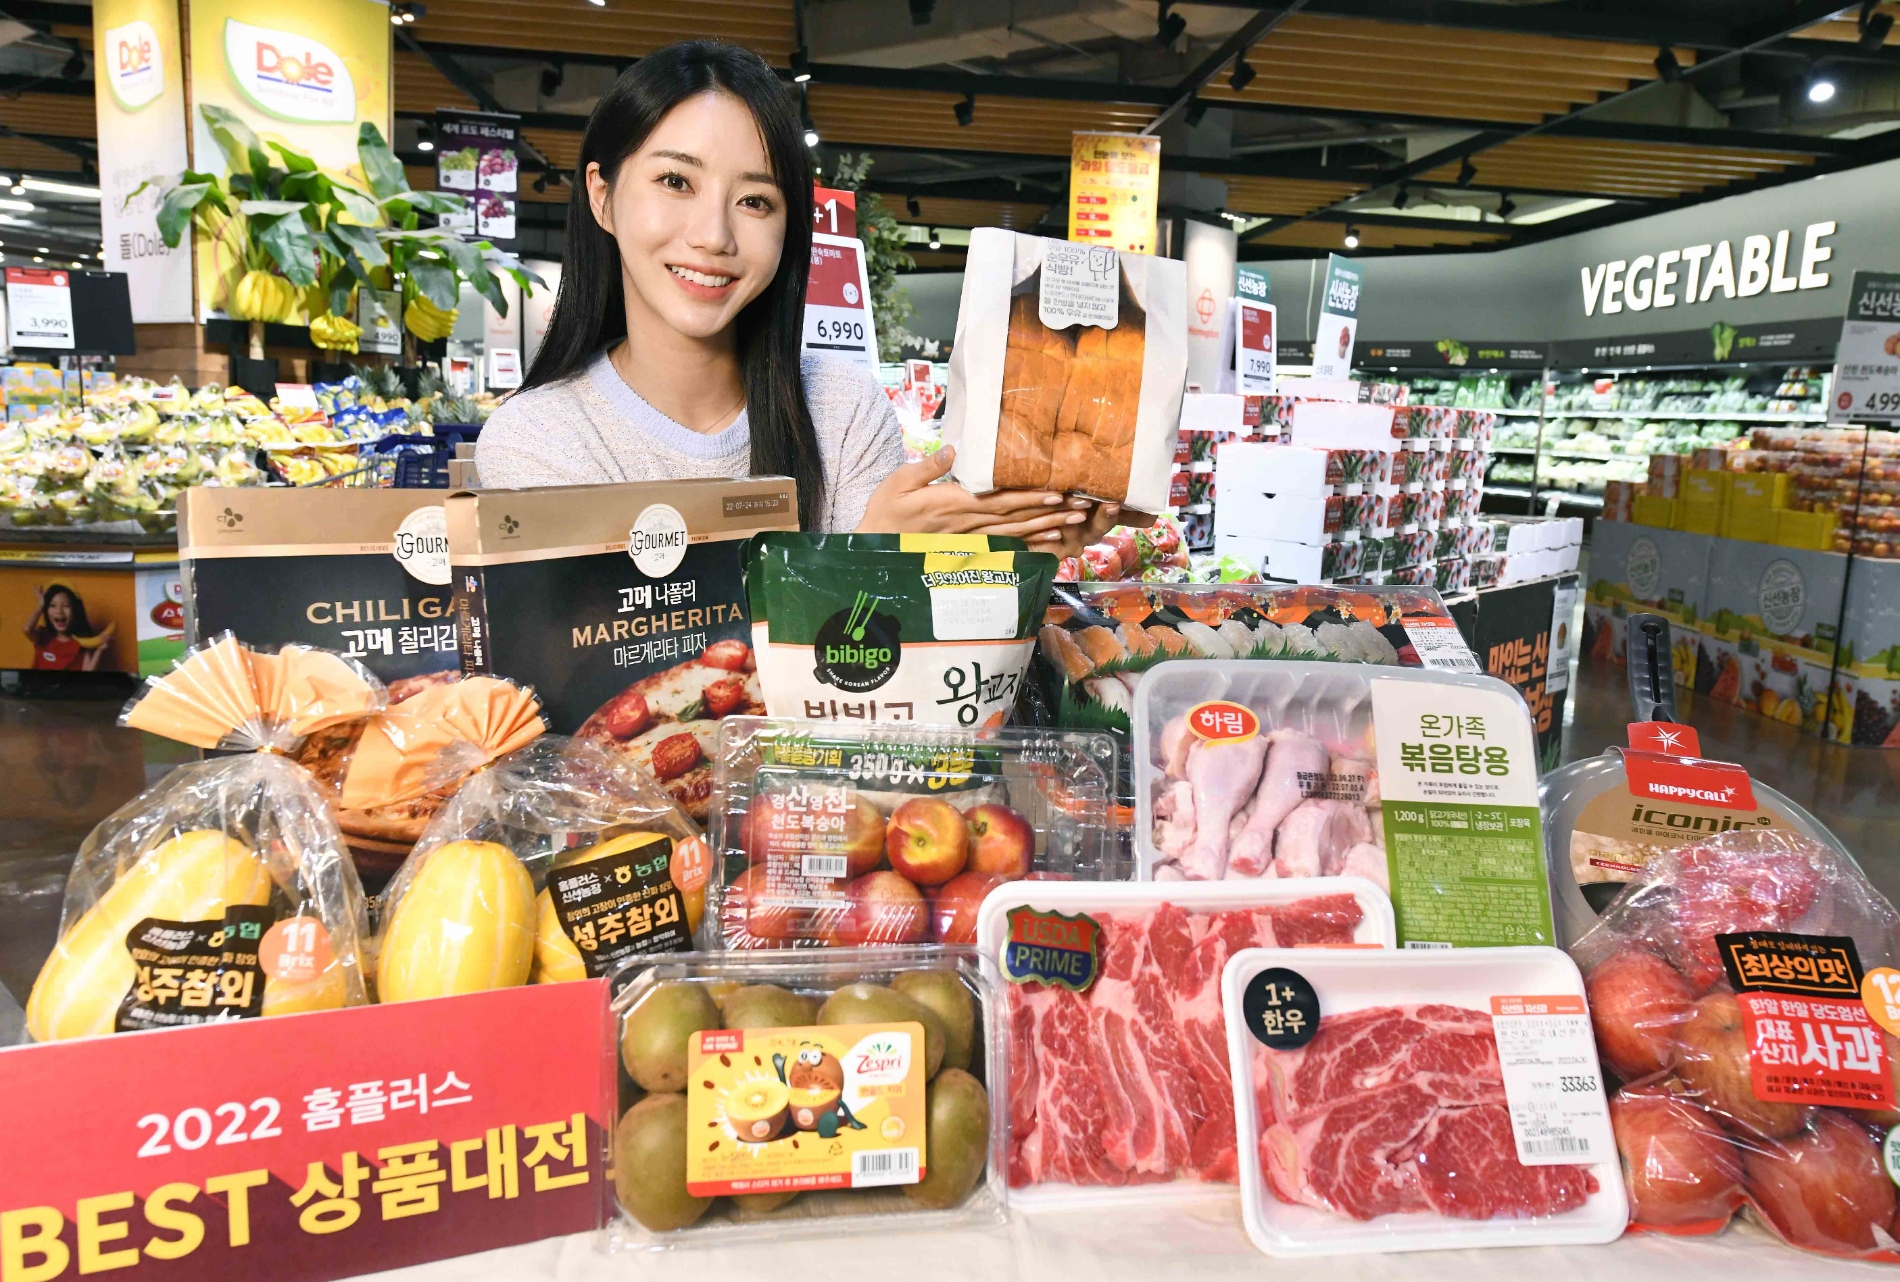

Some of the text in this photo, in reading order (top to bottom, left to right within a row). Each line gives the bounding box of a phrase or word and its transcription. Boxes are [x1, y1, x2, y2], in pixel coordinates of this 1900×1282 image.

[118, 37, 152, 73] Dole
[256, 41, 334, 85] Dole
[1581, 221, 1836, 316] VEGETABLE
[31, 317, 69, 330] 3,990
[1043, 306, 1065, 316] 100%
[817, 319, 865, 342] 6,990
[1250, 358, 1271, 374] 7,990
[935, 569, 982, 587] 맛있어진
[982, 571, 1022, 587] 왕교자!
[617, 580, 697, 614] 고메 나폴리
[305, 598, 411, 625] CHILI
[571, 602, 745, 650] MARGHERITA
[341, 626, 395, 659] 고메
[613, 631, 708, 669] 마르게리타 피자
[826, 644, 893, 670] bibigo
[825, 665, 892, 689] SHARE KOREAN FLAVOR
[1199, 710, 1244, 735] 하림
[1420, 713, 1486, 741] 온가족
[1400, 742, 1510, 777] 볶음탕용
[1648, 782, 1730, 805] HAPPYCALL
[770, 814, 848, 832] 천도복숭아
[678, 839, 702, 868] 11
[558, 872, 600, 892] 홈플러스
[682, 864, 704, 882] Brix
[561, 882, 602, 904] 신선농장
[591, 900, 616, 915] 고장이
[572, 894, 680, 951] 성주참외
[1022, 918, 1081, 949] USDA
[281, 922, 317, 953] 11
[278, 953, 316, 968] Brix
[1014, 945, 1085, 976] PRIME
[1265, 982, 1297, 1006] 1+
[1262, 1008, 1308, 1036] 한우
[1748, 997, 1780, 1016] 한알
[1780, 1000, 1810, 1019] 한알
[1810, 1003, 1870, 1023] 당도엄선
[1755, 1018, 1797, 1043] 대표
[1759, 1041, 1800, 1067] 산지
[1801, 1021, 1884, 1076] 사과
[857, 1055, 902, 1075] Zespri
[136, 1069, 474, 1158] 2022 홈플러스
[0, 1112, 590, 1282] BEST 상품대전
